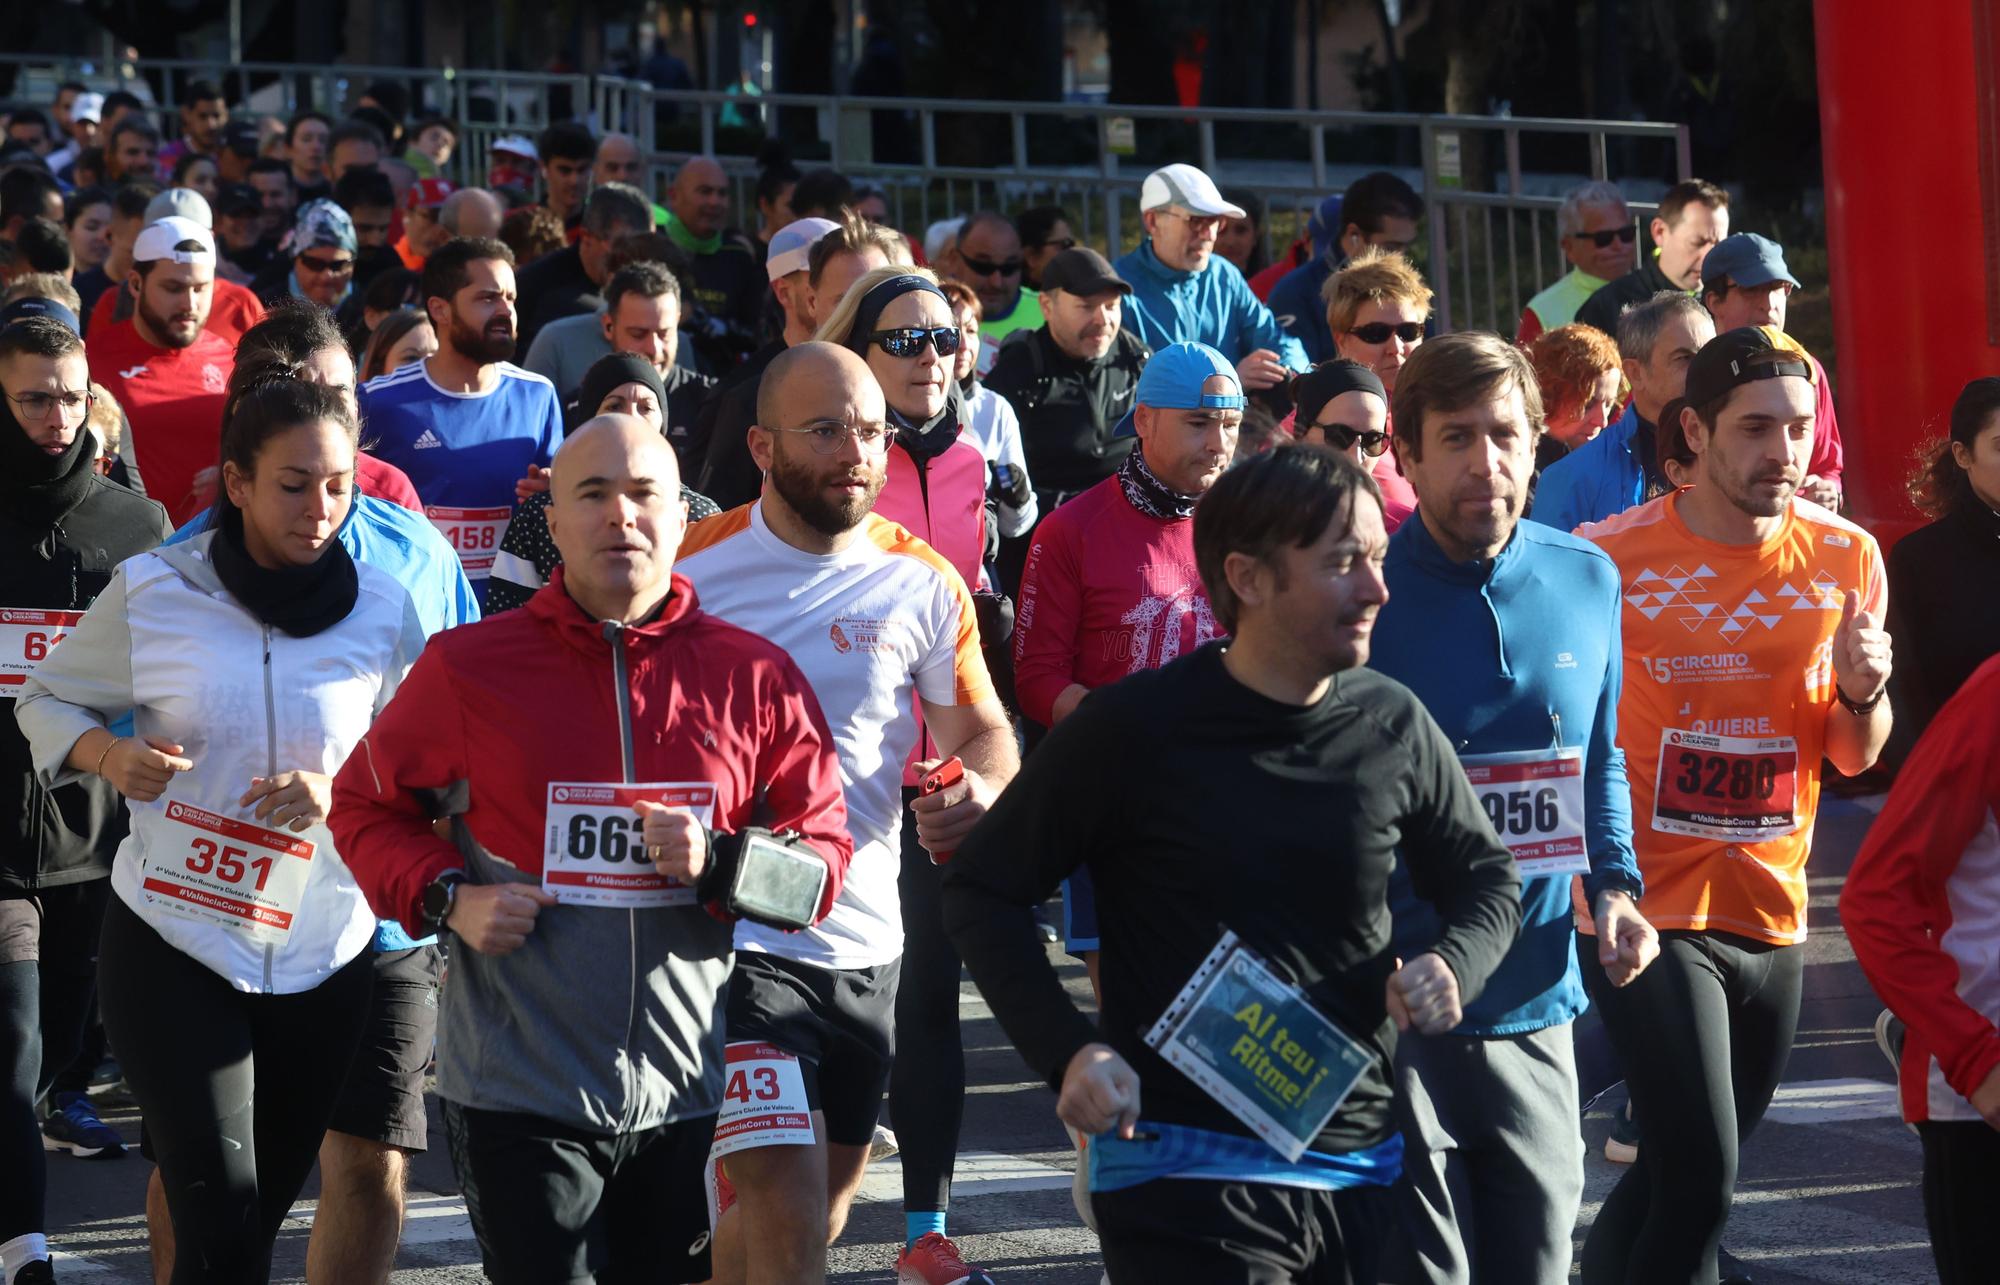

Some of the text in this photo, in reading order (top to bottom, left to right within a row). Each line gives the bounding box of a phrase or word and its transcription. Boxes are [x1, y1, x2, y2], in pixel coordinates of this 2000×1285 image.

[447, 526, 495, 549] 158
[1671, 653, 1749, 670] CIRCUITO
[1677, 752, 1776, 800] 3280
[1481, 788, 1558, 836] 956
[164, 868, 180, 878] Volta
[198, 878, 224, 891] Runners
[185, 836, 273, 892] 351
[179, 888, 246, 914] #ValènciaCorre
[1233, 1002, 1277, 1040] Al
[1270, 1026, 1315, 1076] teu
[725, 1067, 781, 1103] 43
[743, 1104, 763, 1114] Ciutat
[771, 1103, 795, 1111] València
